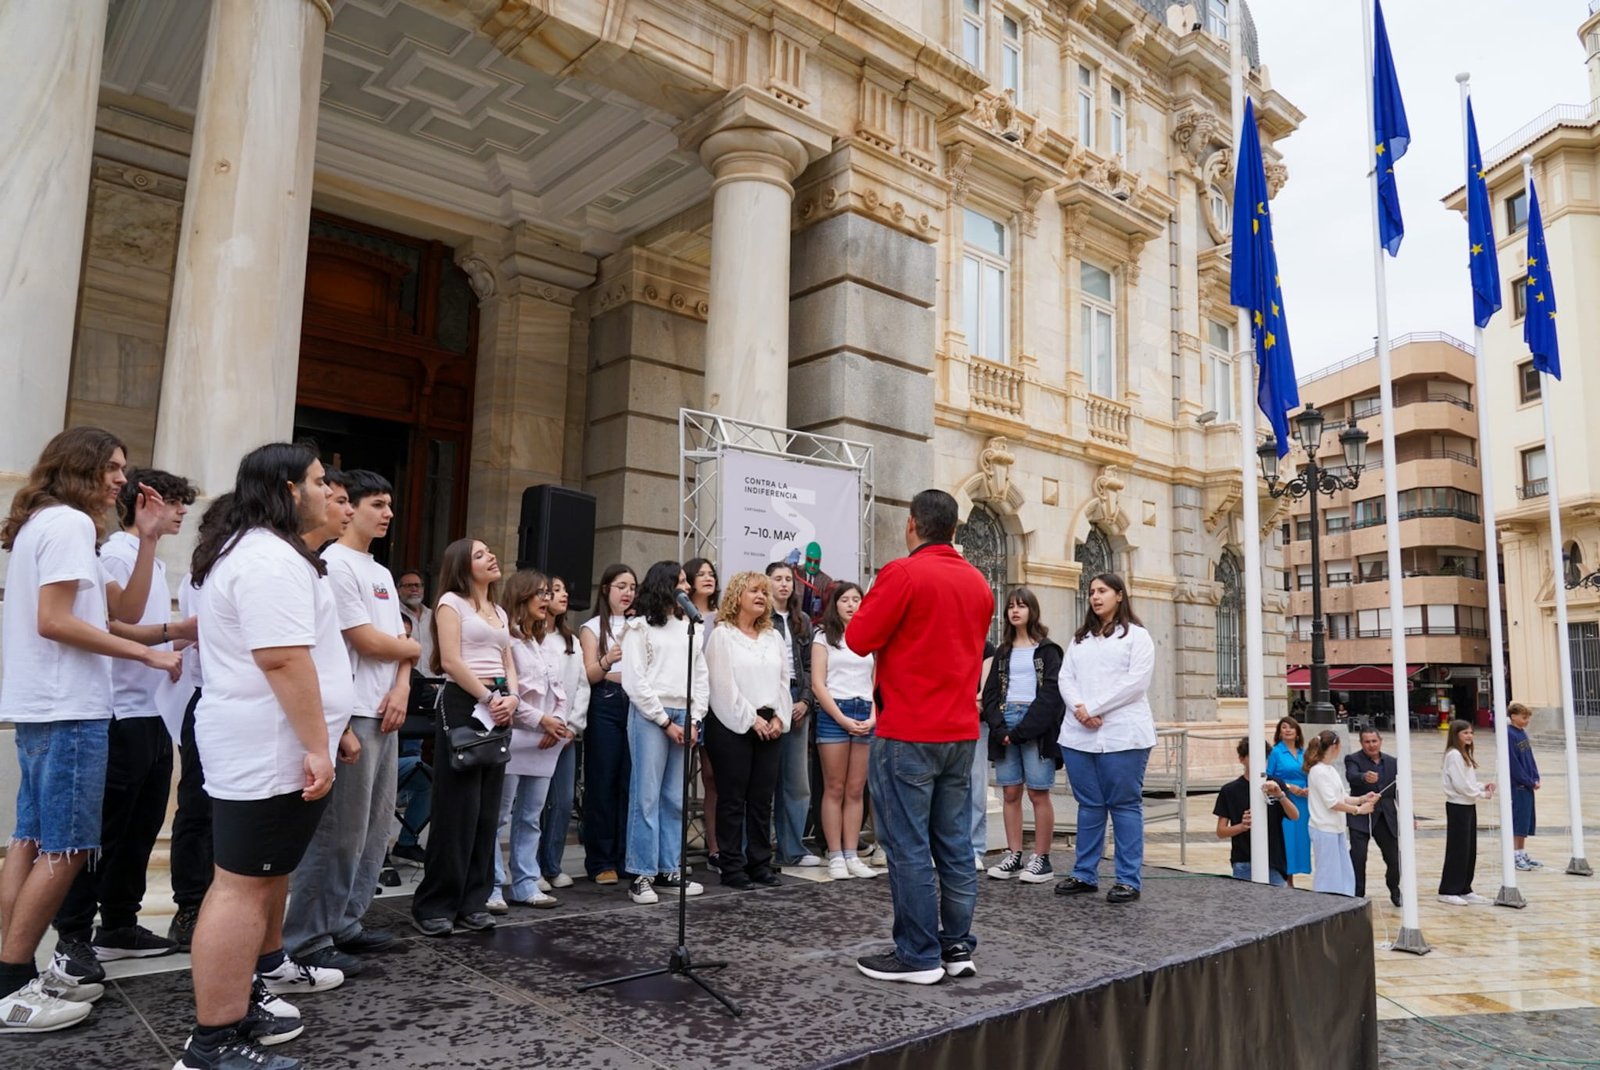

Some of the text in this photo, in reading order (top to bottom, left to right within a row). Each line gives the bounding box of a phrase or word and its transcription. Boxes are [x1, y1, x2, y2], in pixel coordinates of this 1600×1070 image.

[744, 476, 788, 490] CONTRA LA
[744, 486, 798, 500] INDIFERENCIA
[773, 529, 797, 541] MAY
